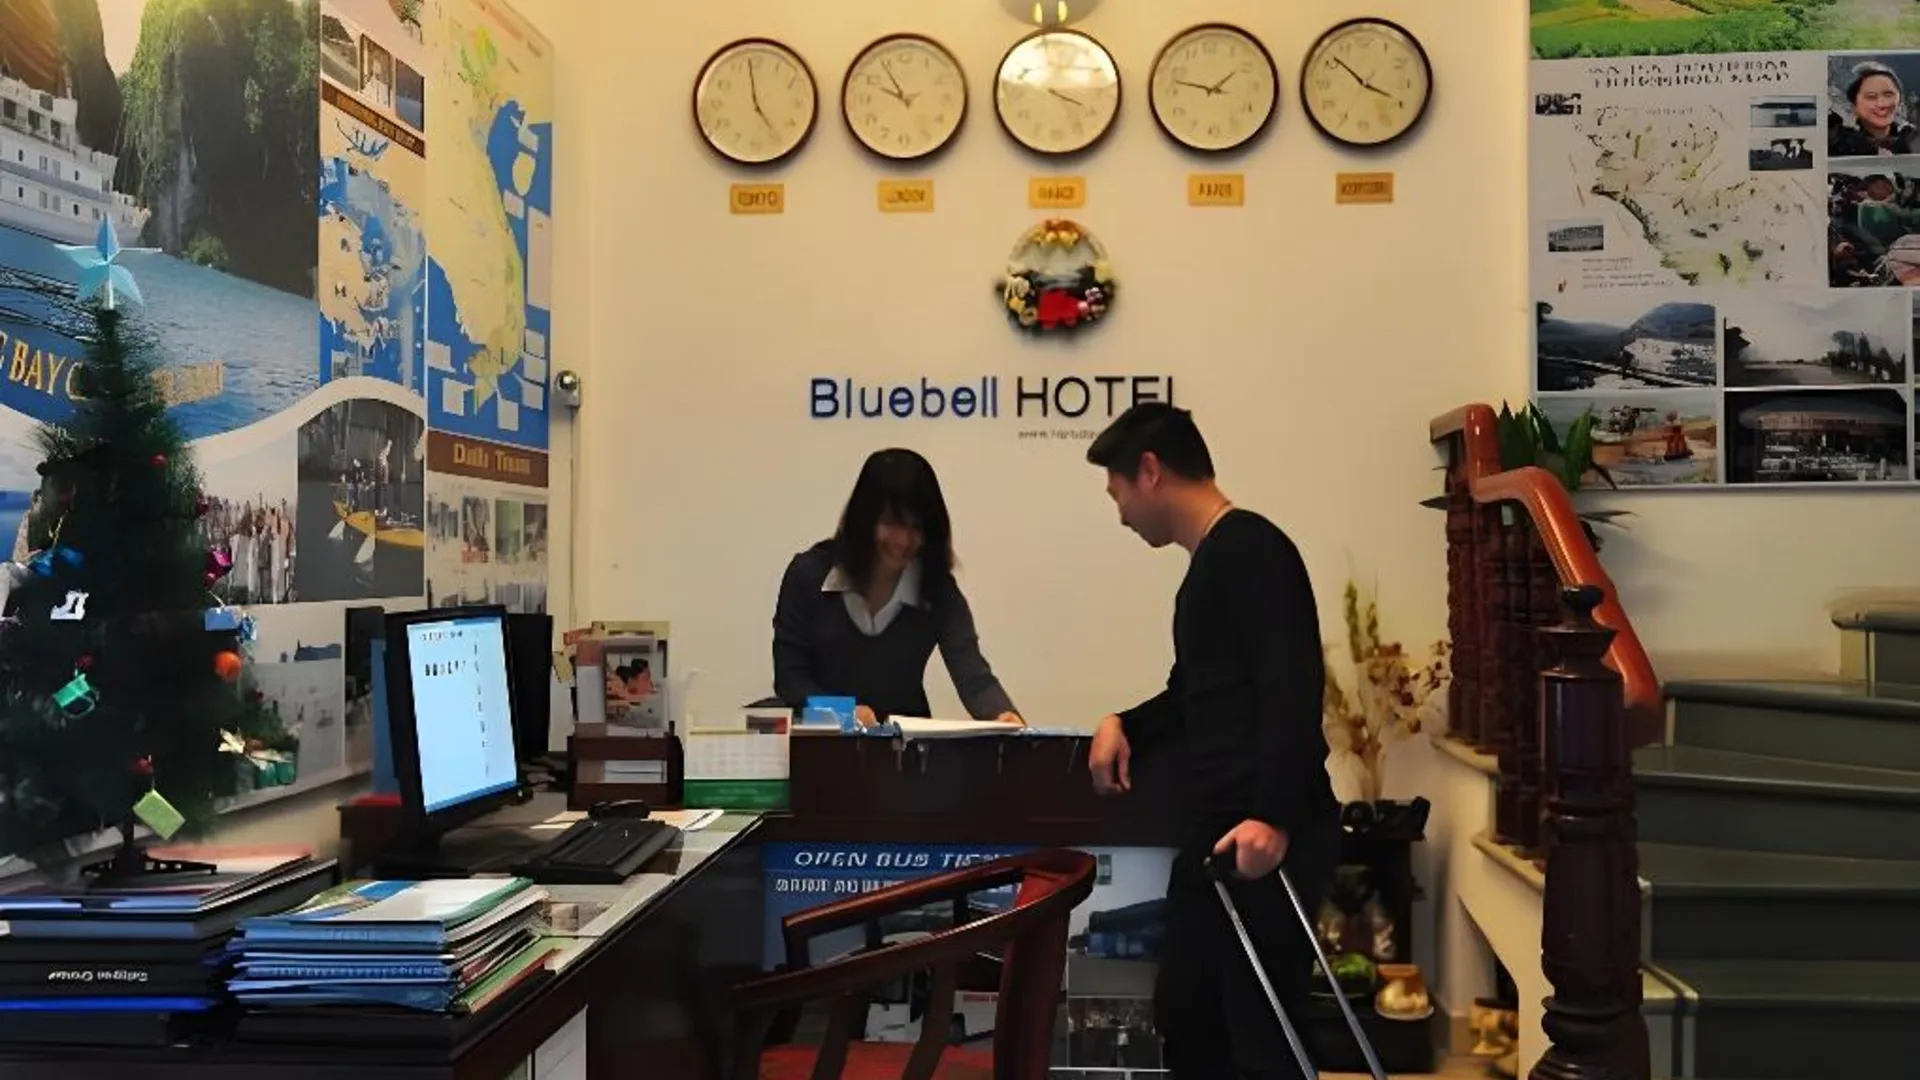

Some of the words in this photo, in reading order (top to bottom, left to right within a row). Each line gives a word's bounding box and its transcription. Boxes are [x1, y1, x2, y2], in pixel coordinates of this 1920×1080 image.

[8, 338, 66, 395] BAY
[810, 376, 998, 418] Bluebell
[794, 851, 867, 867] OPEN
